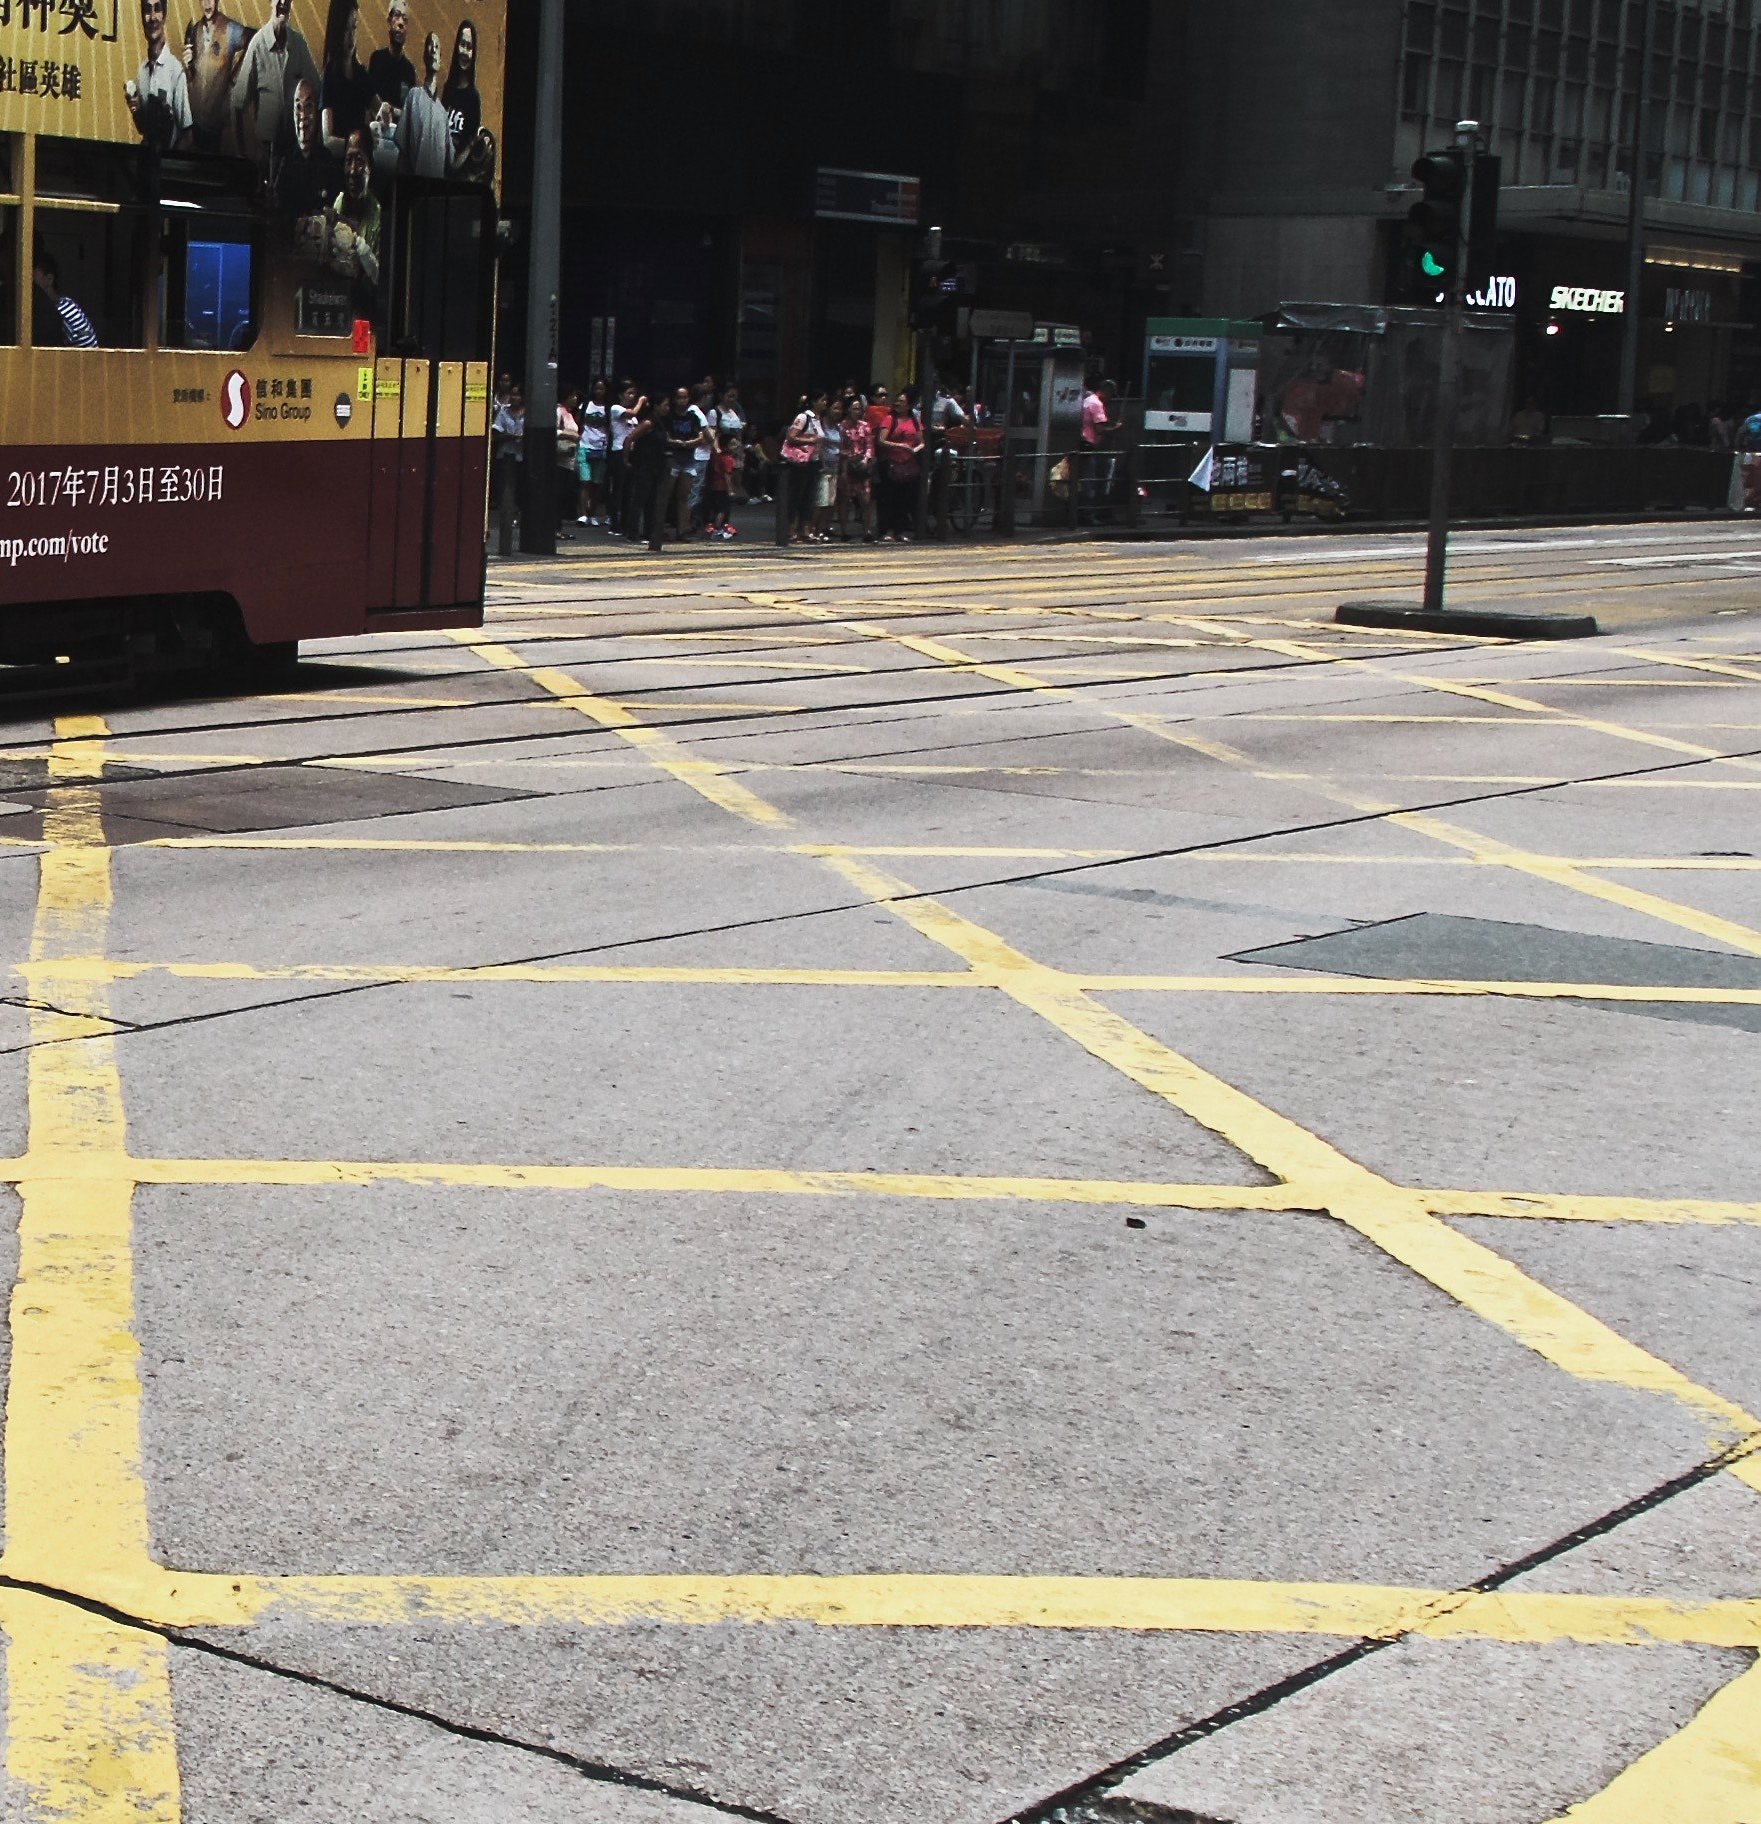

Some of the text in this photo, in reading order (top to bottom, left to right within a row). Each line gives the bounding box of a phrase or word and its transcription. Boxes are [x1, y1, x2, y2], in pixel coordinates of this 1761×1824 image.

[1549, 286, 1625, 313] SKECHER
[254, 402, 278, 421] Sino
[280, 402, 312, 423] Group
